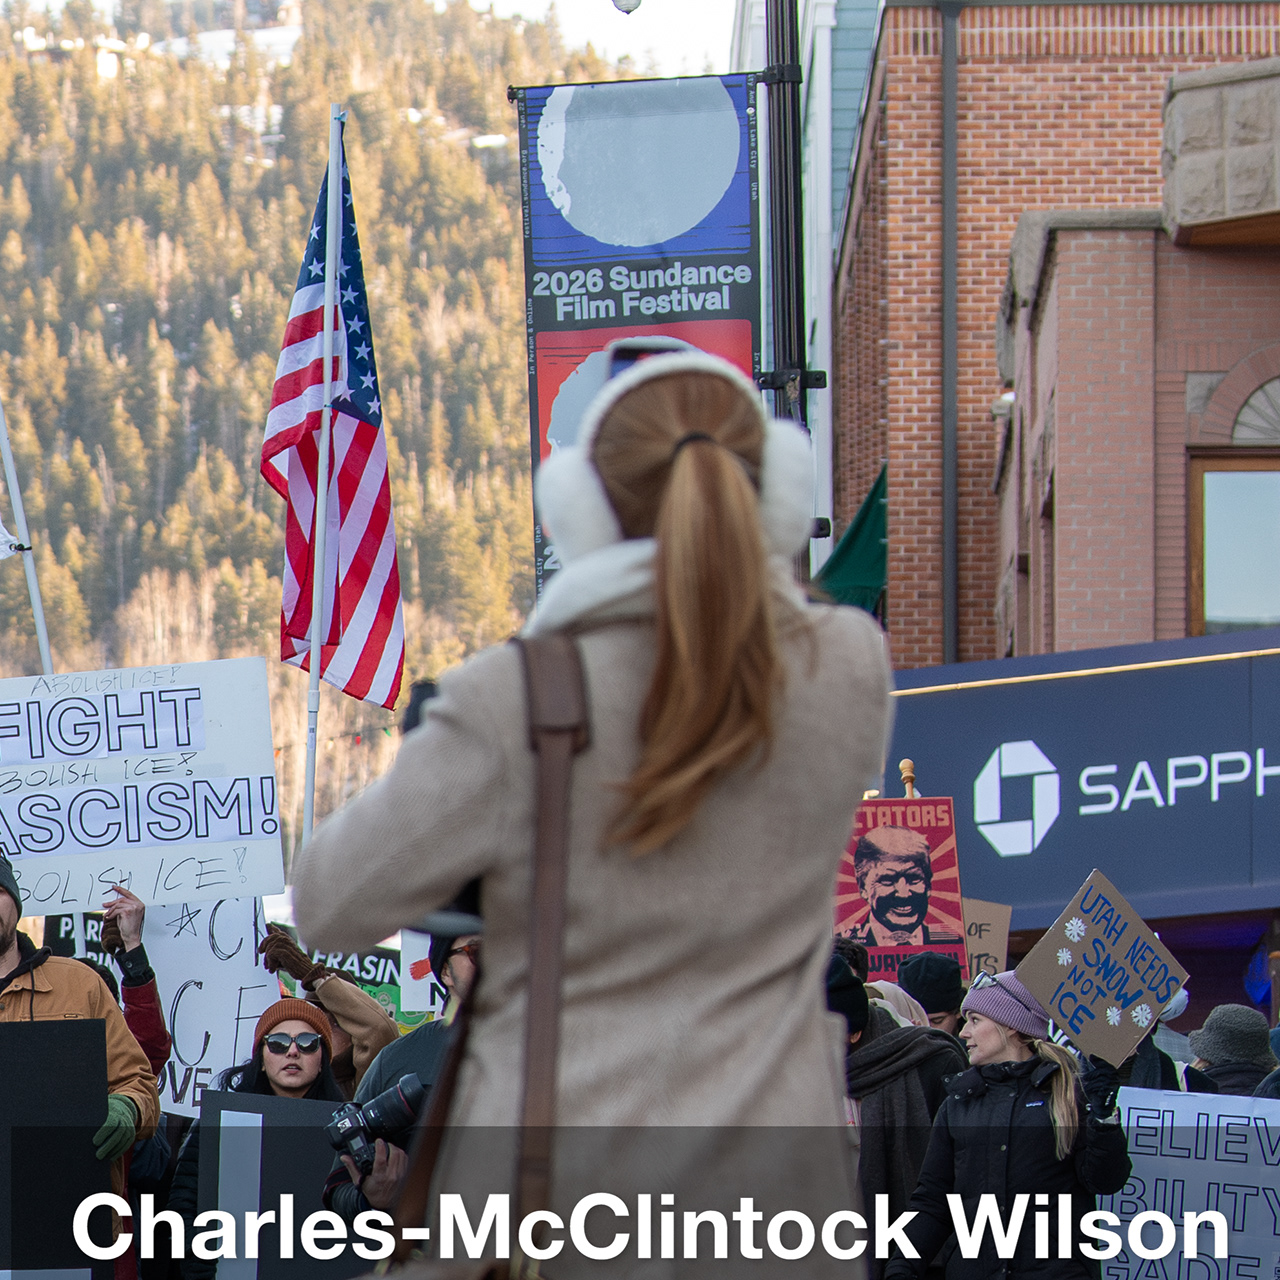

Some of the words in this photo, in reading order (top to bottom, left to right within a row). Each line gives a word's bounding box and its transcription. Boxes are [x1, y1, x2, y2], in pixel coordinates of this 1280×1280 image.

[533, 268, 604, 297] 2026
[609, 262, 753, 291] Sundance
[556, 294, 616, 321] Film
[622, 285, 731, 317] Festival
[31, 671, 123, 698] ABOLISH
[130, 665, 181, 689] ICE!
[124, 751, 198, 781] ICE!
[151, 846, 248, 900] ICE!
[968, 922, 991, 939] OF
[1079, 885, 1129, 946] UTAH
[1124, 936, 1180, 1004] NEEDS
[1067, 965, 1108, 1006] NOT
[1083, 938, 1144, 1009] SNOW
[1049, 981, 1096, 1036] ICE
[1126, 1106, 1280, 1166] ELIEV
